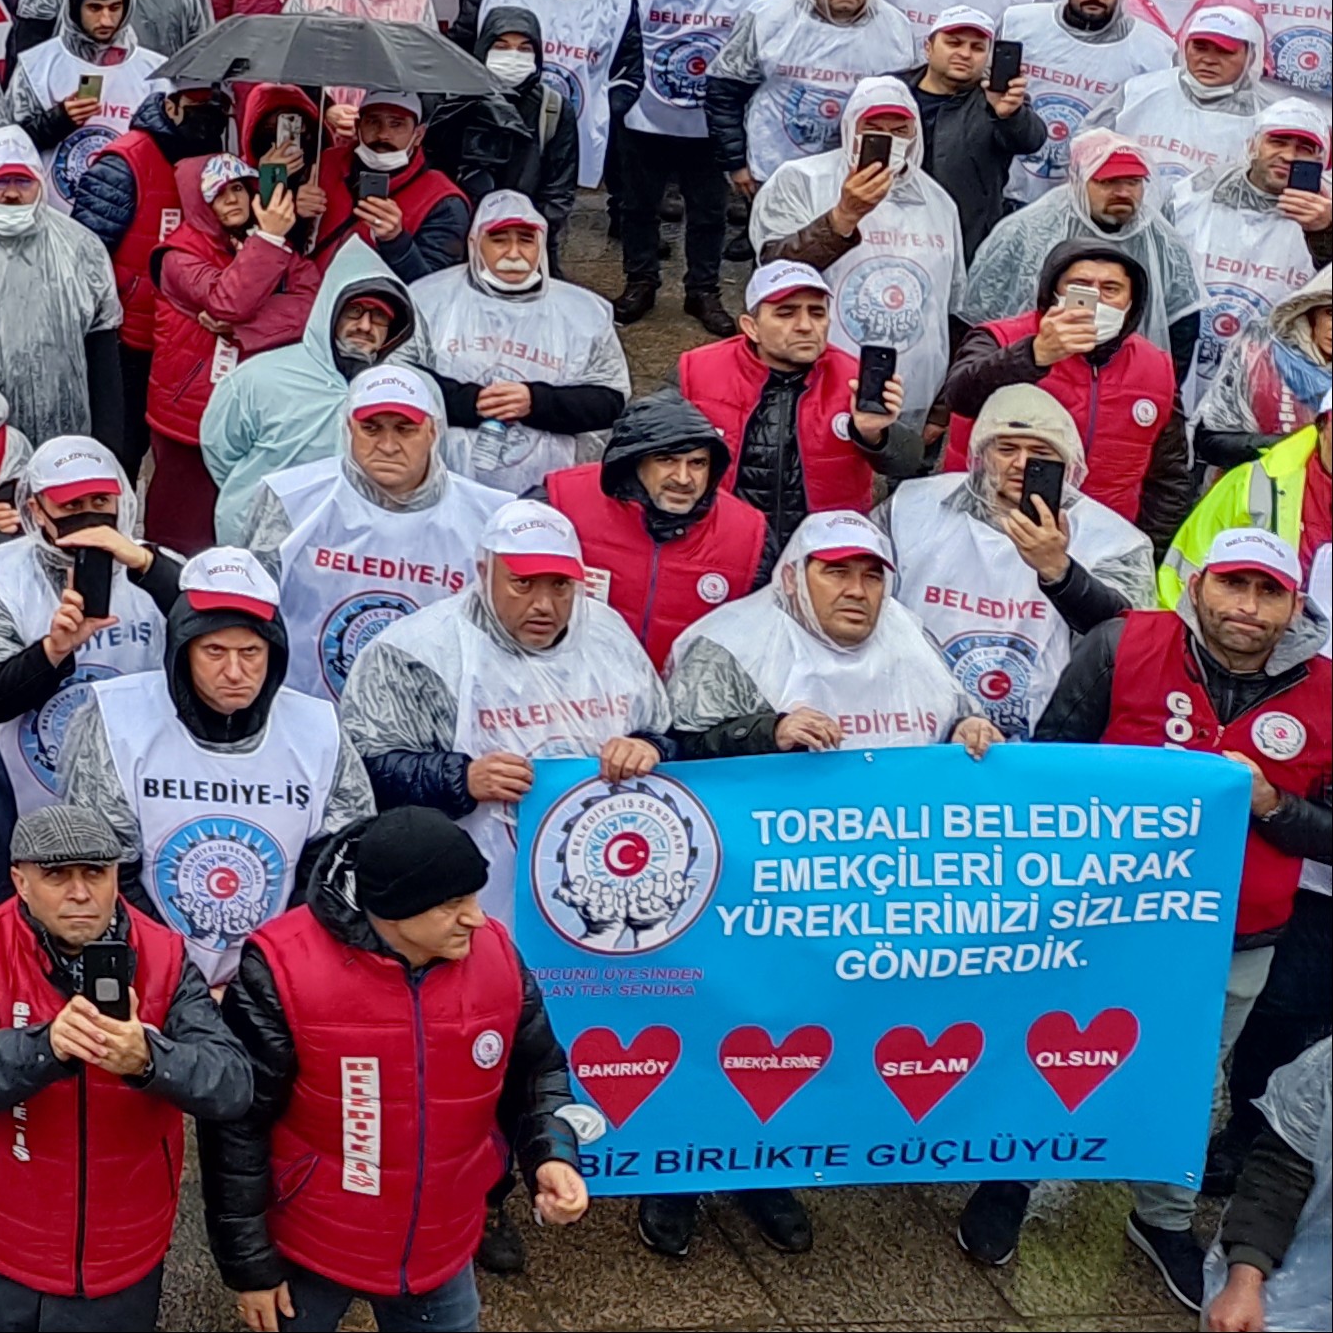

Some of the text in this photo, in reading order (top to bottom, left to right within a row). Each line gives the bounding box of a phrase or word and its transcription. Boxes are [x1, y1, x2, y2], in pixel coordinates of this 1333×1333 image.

[314, 548, 464, 594] BELEDİYE-İŞ
[143, 776, 310, 813] BELEDİYE-İŞ
[752, 798, 1201, 848] TORBALI BELEDİYESİ
[754, 848, 1192, 897] EMEKÇİLERİ OLARAK
[716, 887, 1222, 938] YÜREKLERİMİZİ SİZLERE
[834, 940, 1089, 982] GÖNDERDİK.
[577, 1058, 669, 1079] BAKIRKÖY
[882, 1057, 969, 1077] SELAM
[1035, 1049, 1119, 1068] OLSUN
[655, 1141, 850, 1175] BİRLİKTE
[866, 1133, 1108, 1167] GÜÇLÜYÜZ
